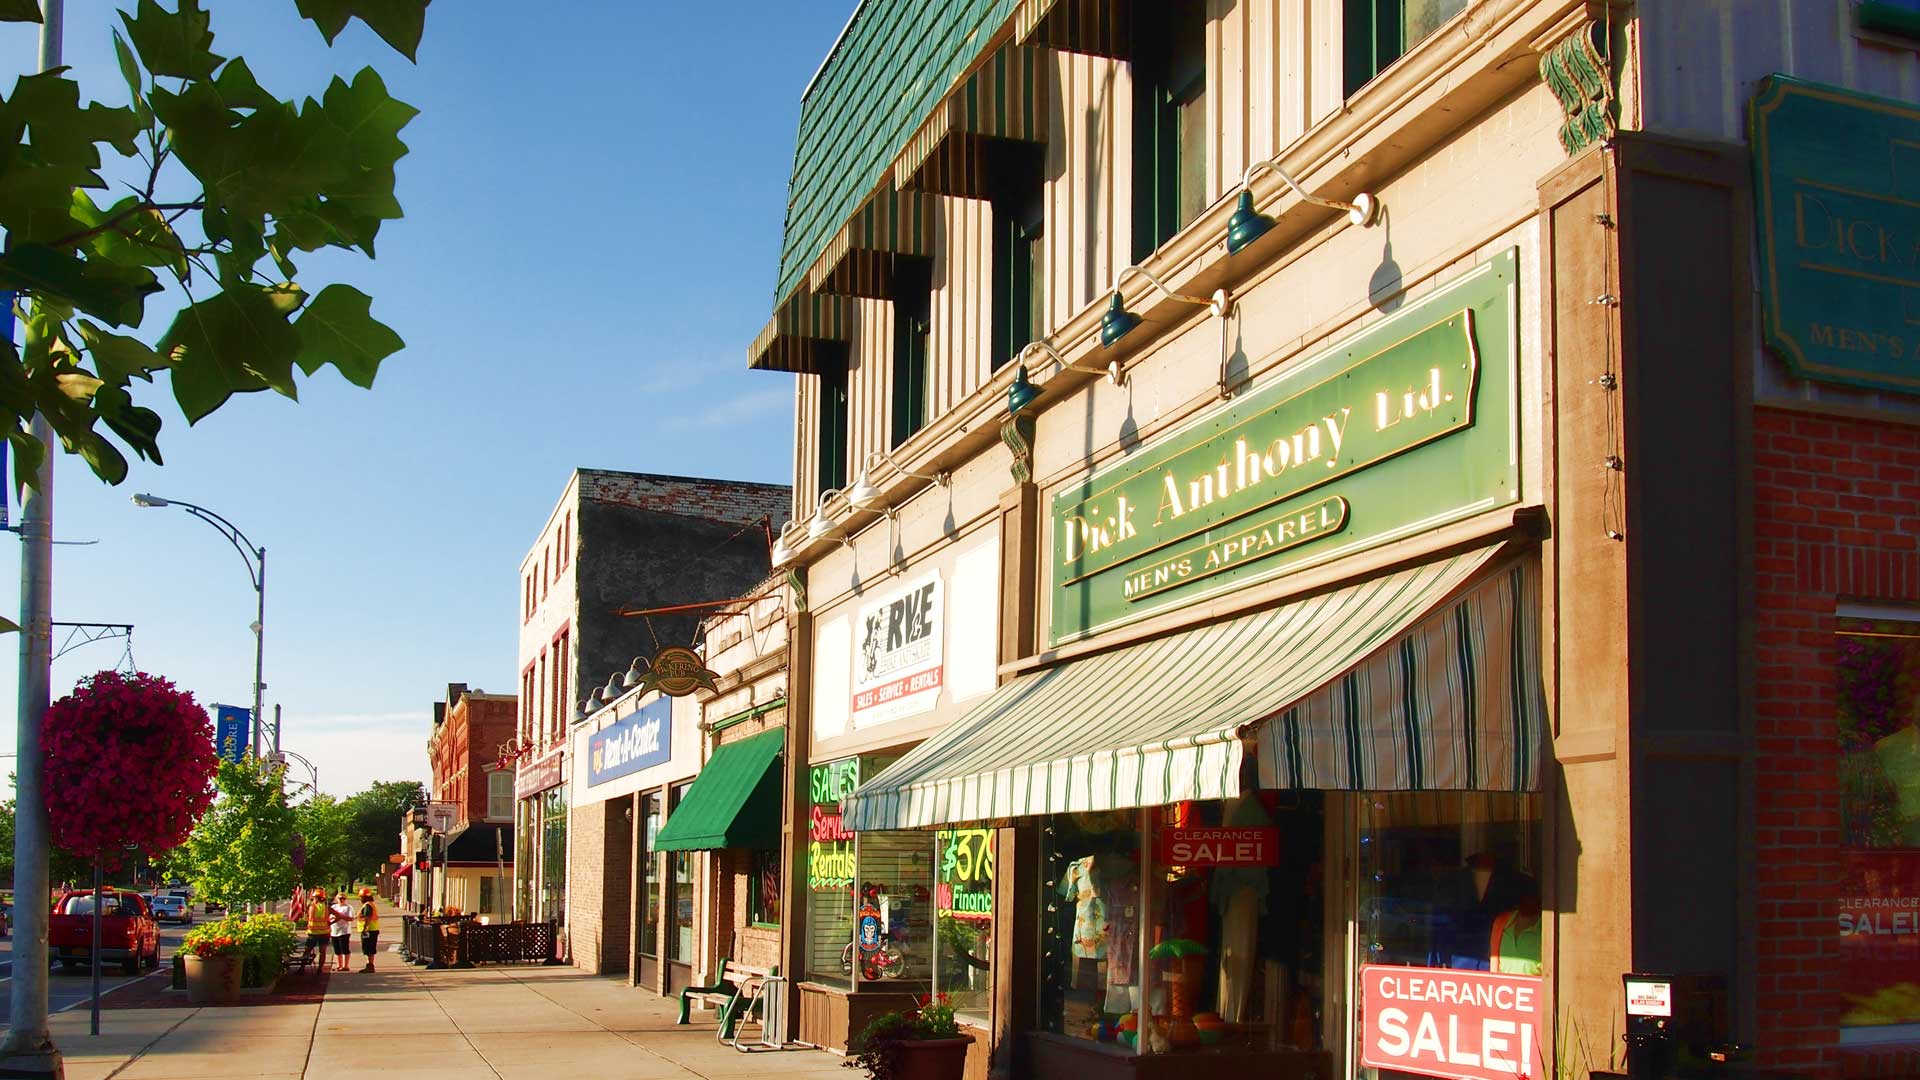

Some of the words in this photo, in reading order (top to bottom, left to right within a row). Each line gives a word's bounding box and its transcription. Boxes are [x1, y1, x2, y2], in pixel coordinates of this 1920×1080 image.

[1809, 322, 1905, 360] MEN'S
[1063, 492, 1137, 565] Dick
[1153, 407, 1350, 527] Anthony
[1375, 367, 1454, 433] Ltd.
[1124, 559, 1192, 598] MEN'S
[1204, 506, 1335, 569] APPAREL
[656, 662, 699, 675] PICKERING
[670, 670, 686, 678] PUB
[857, 692, 873, 709] SALES
[879, 681, 904, 702] SERVICE
[910, 669, 939, 693] RENTALS
[811, 760, 857, 804] SALES
[812, 805, 853, 842] Servi
[1173, 831, 1264, 841] CLEARANCE
[811, 841, 856, 880] Rentals
[1172, 843, 1263, 862] SALE!
[938, 884, 951, 909] We
[1838, 912, 1919, 937] SALE!
[1379, 976, 1535, 1013] CLEARANCE
[1377, 1007, 1533, 1077] SALE!
